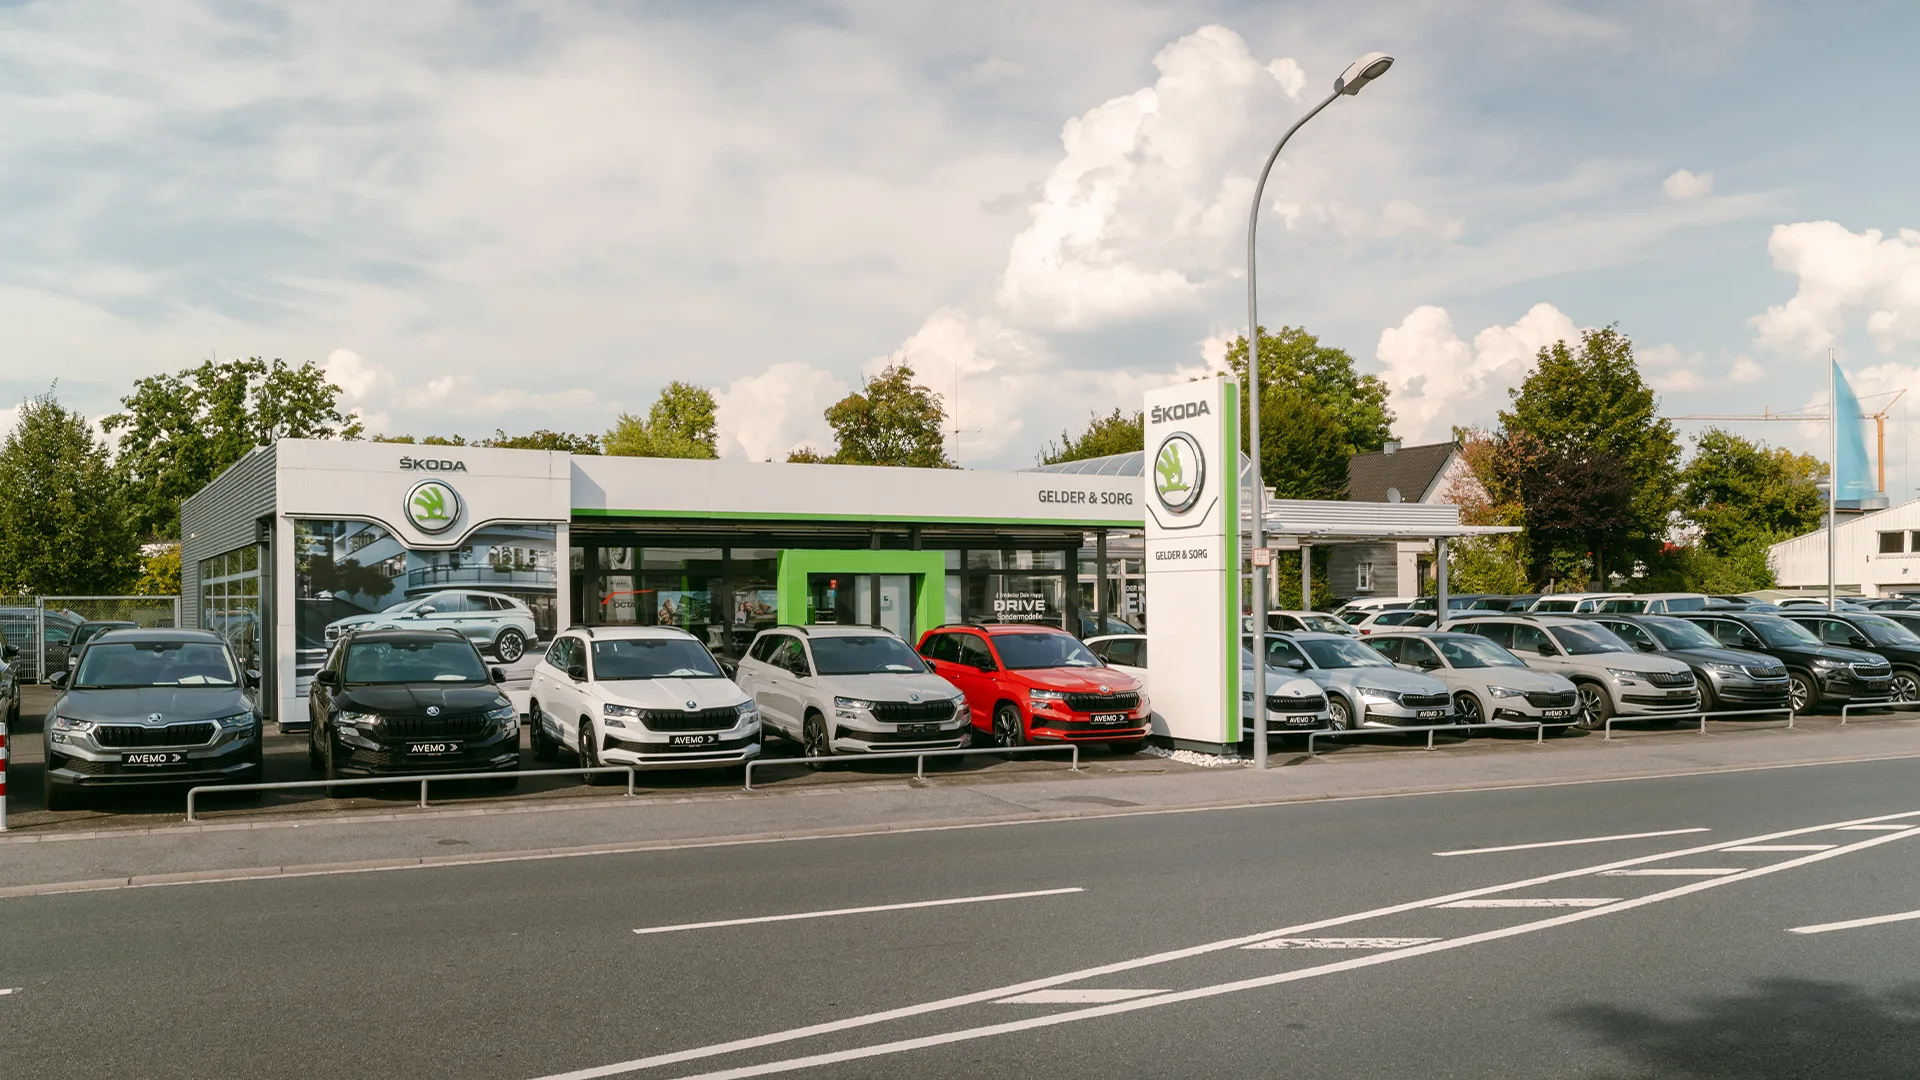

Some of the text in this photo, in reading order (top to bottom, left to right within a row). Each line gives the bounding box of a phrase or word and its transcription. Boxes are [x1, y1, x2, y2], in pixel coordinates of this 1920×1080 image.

[1151, 400, 1211, 424] ŠKODA
[399, 456, 467, 472] ŠKODA
[1038, 490, 1133, 505] GELDER & SORG
[1155, 549, 1208, 560] GELDER & SORG
[993, 599, 1046, 611] DRIVE
[997, 612, 1043, 621] Sondermodelle
[1093, 714, 1117, 722] AVEMO
[1419, 710, 1438, 718] AVEMO
[674, 735, 704, 744] AVEMO
[411, 743, 446, 753] AVEMO
[127, 754, 167, 763] AVEMO
